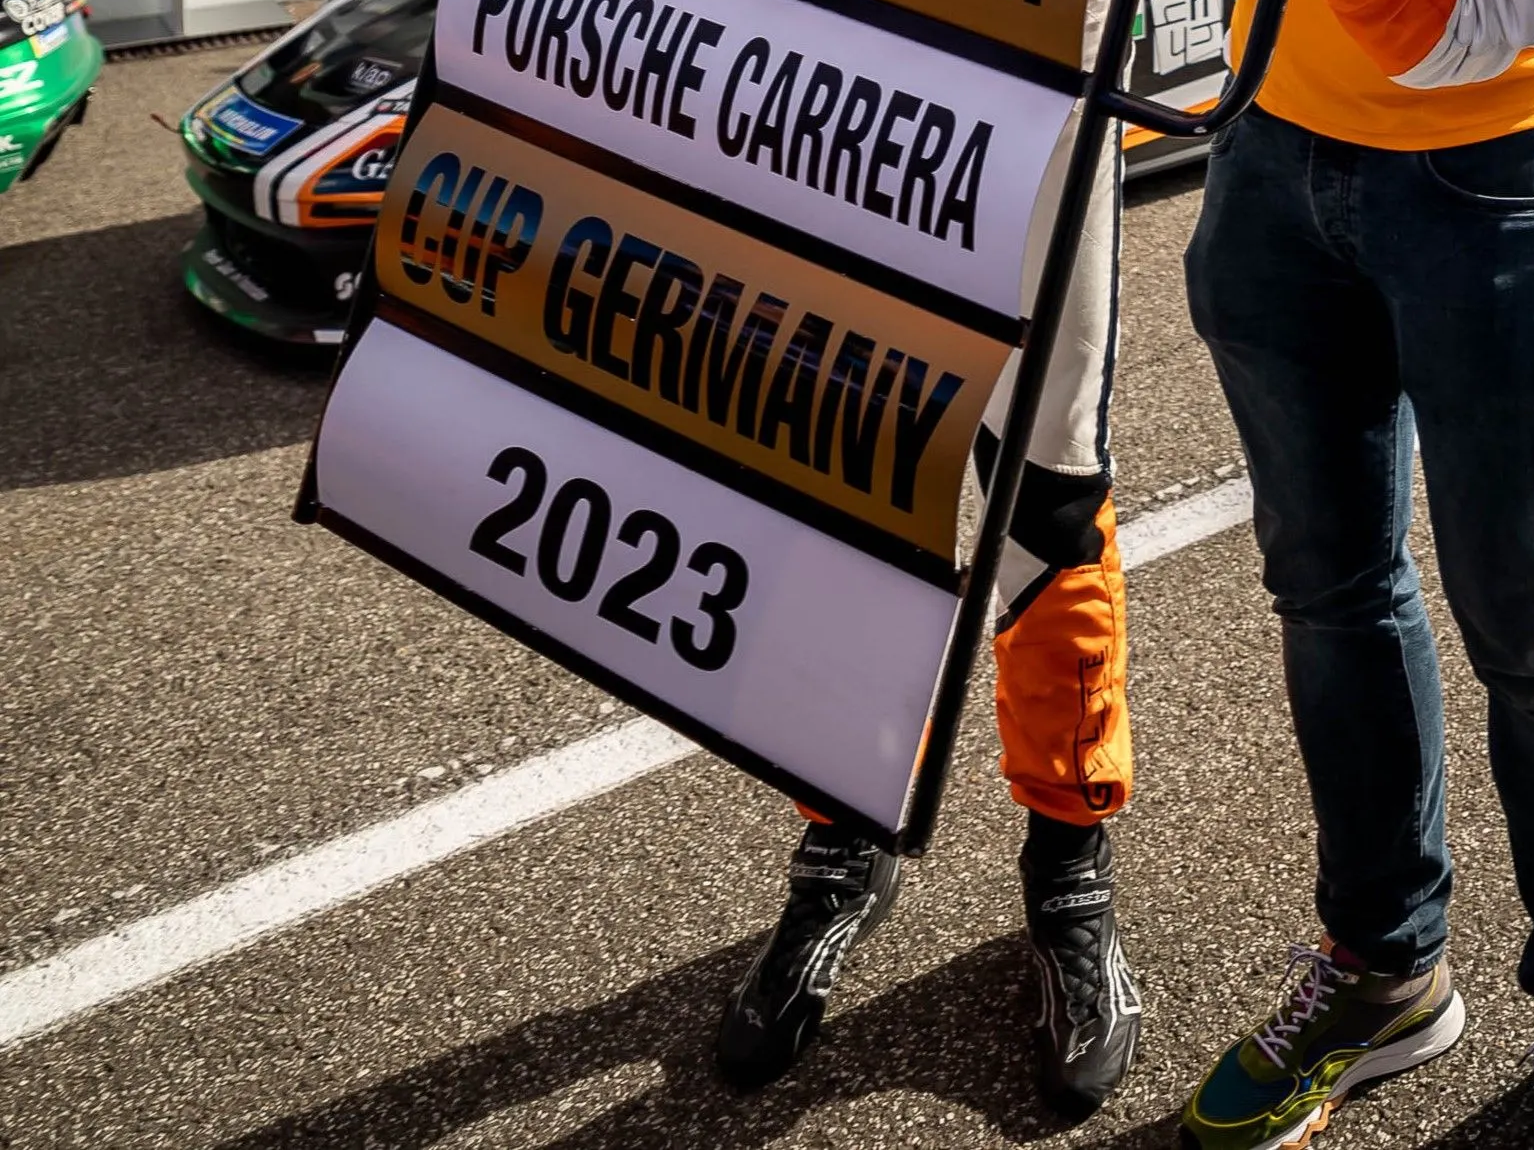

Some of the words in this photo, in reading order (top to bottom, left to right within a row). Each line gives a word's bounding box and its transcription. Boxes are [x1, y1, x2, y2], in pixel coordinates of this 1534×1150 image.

[716, 36, 995, 254] CARRERA
[400, 152, 545, 314] CUP
[543, 214, 966, 516] GERMANY
[468, 446, 751, 673] 2023
